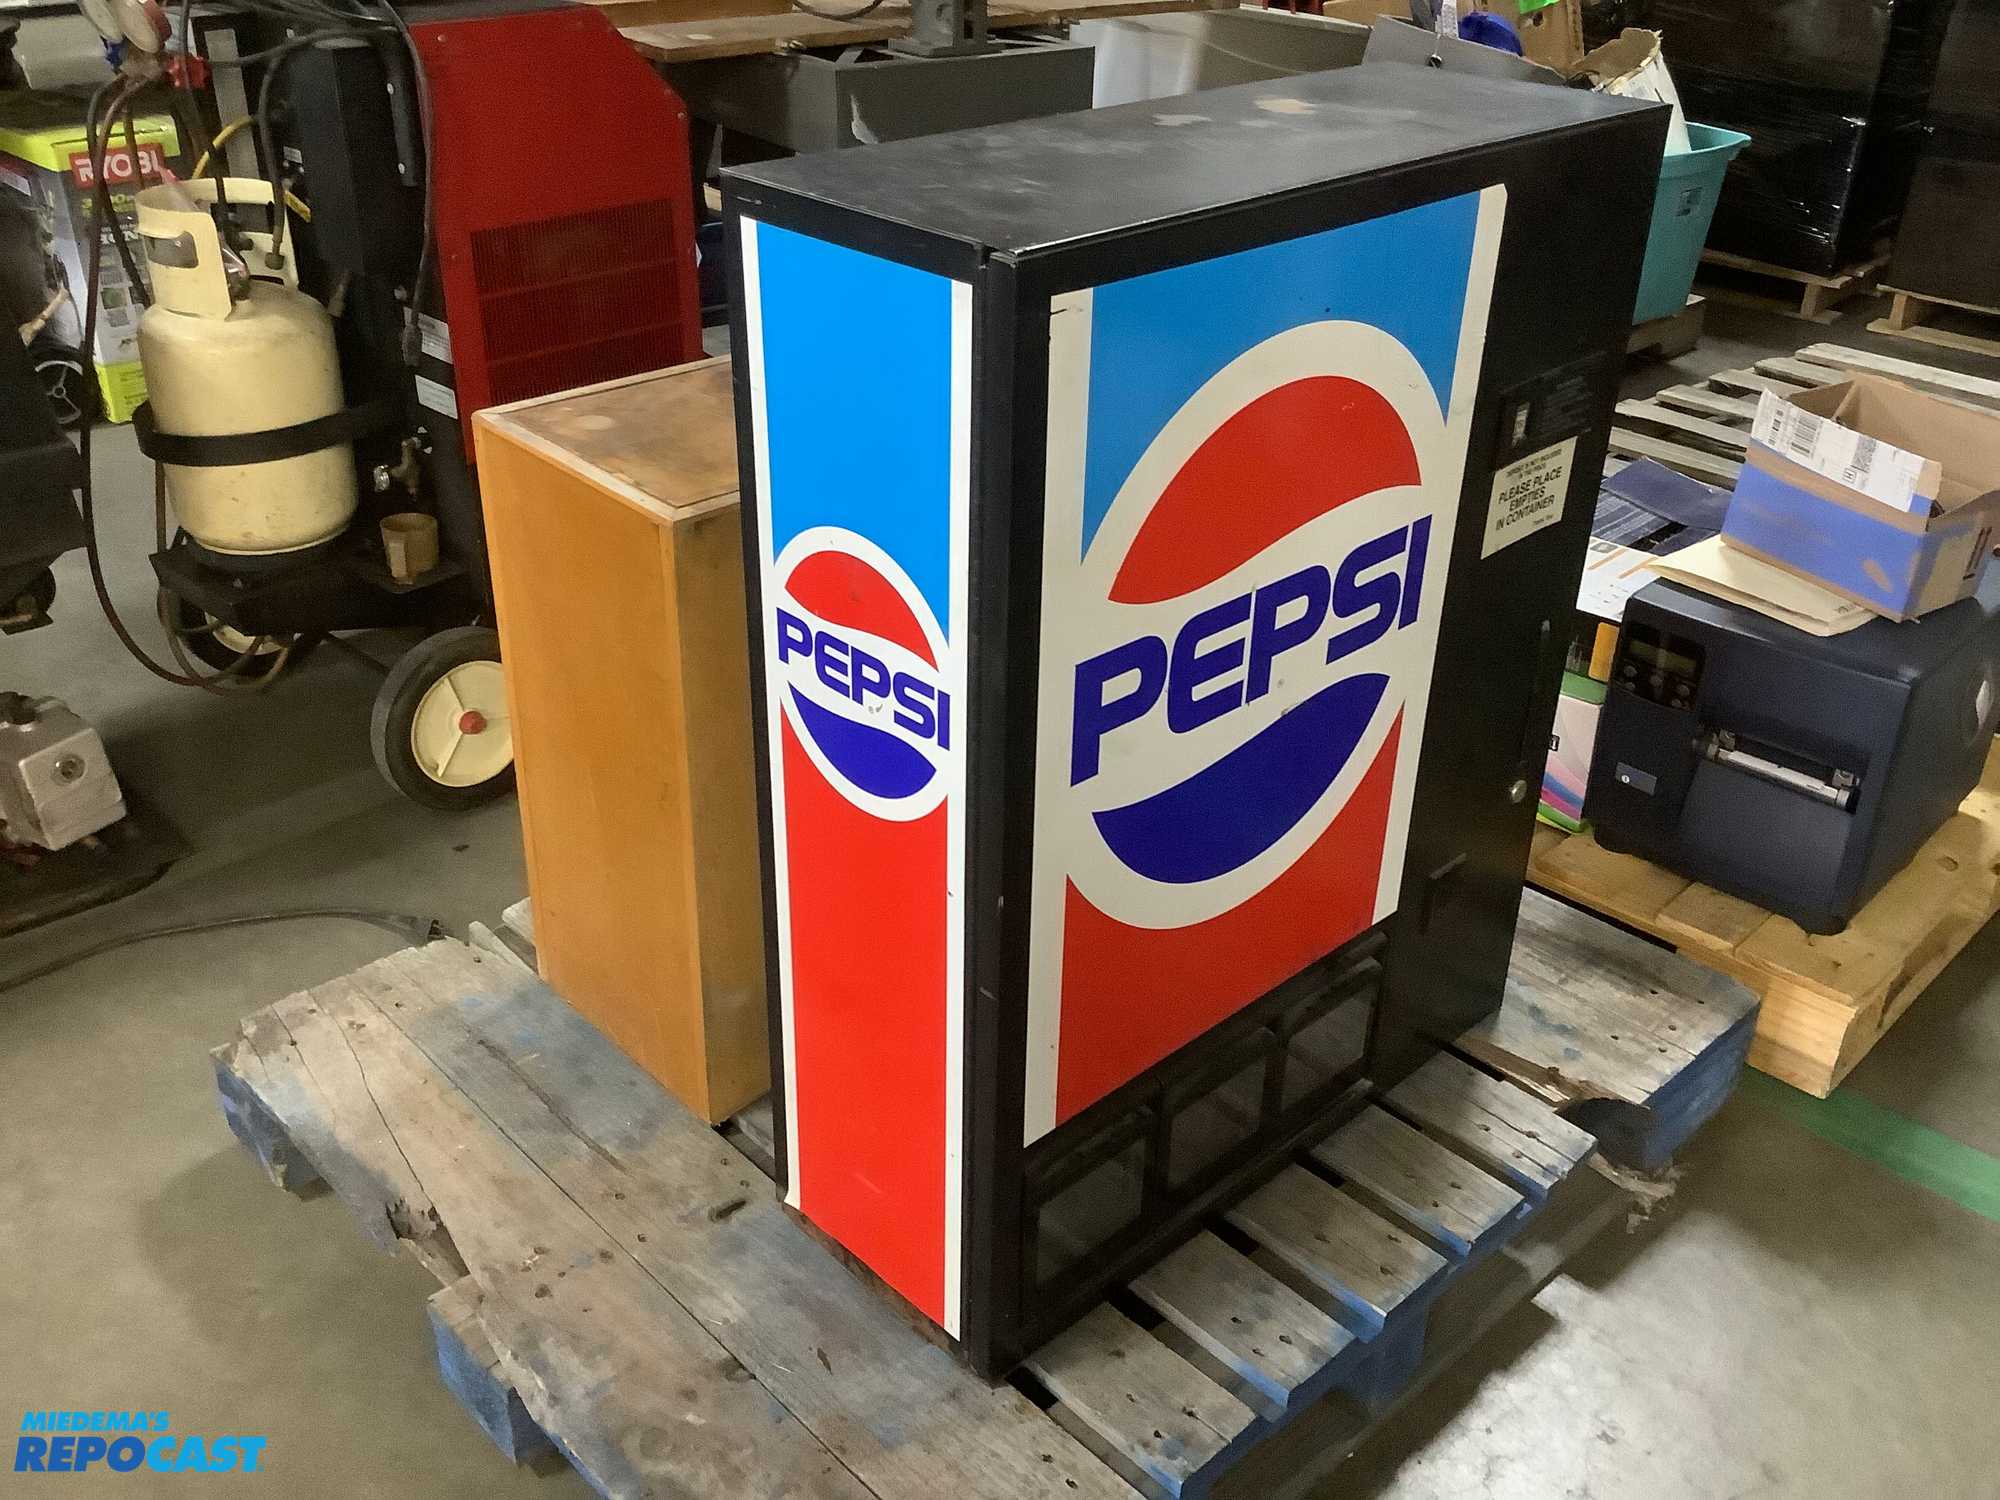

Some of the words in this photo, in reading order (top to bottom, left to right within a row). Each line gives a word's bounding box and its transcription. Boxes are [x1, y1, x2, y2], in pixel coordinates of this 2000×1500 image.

[1499, 479, 1532, 505] PLEASE
[1533, 466, 1562, 488] PLACE
[1509, 486, 1546, 512] EMPTIES
[1496, 518, 1505, 531] IN
[1506, 495, 1555, 526] CONTAINER
[1070, 514, 1432, 787] PEPSI
[776, 606, 951, 751] PEPSI
